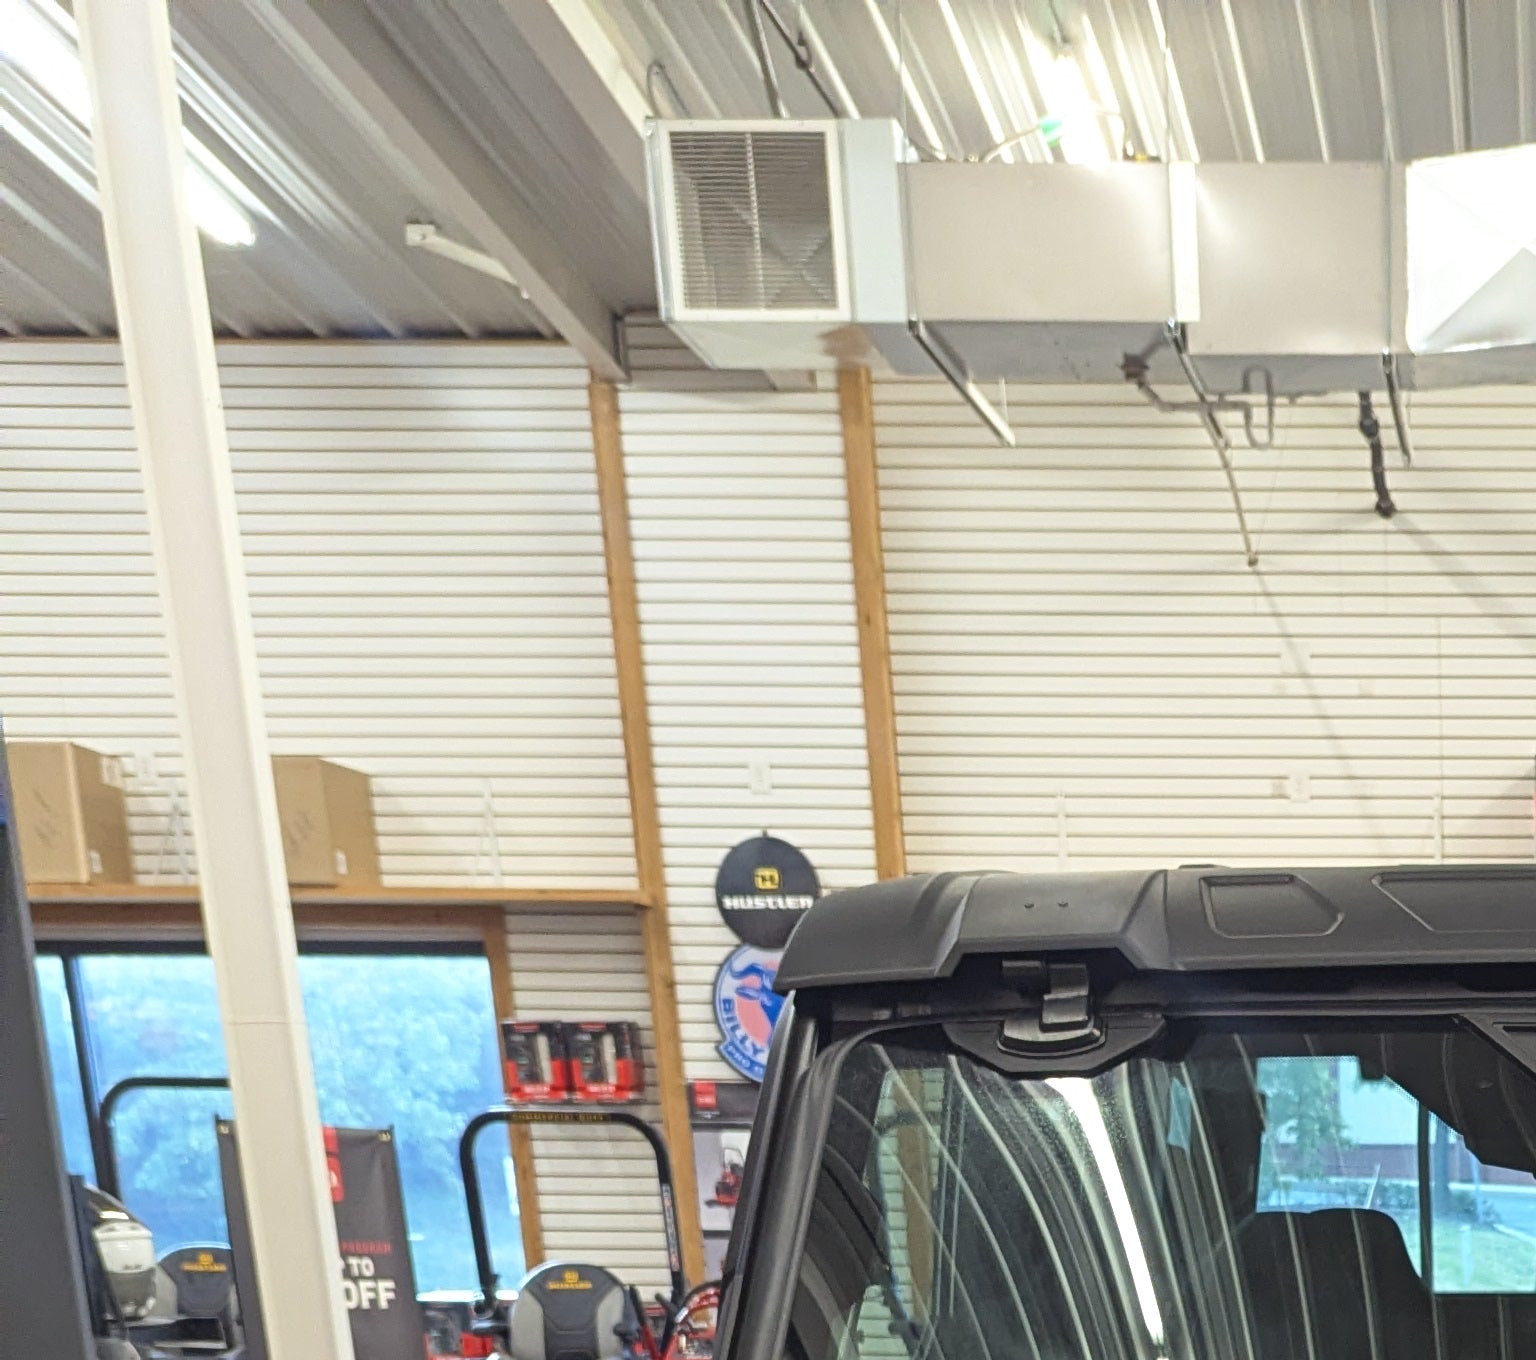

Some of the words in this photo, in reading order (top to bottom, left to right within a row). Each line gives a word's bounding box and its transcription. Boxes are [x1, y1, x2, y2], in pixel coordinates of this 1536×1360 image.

[722, 895, 813, 910] HUSTLER
[347, 1256, 375, 1277] TO
[343, 1280, 396, 1309] OFF
